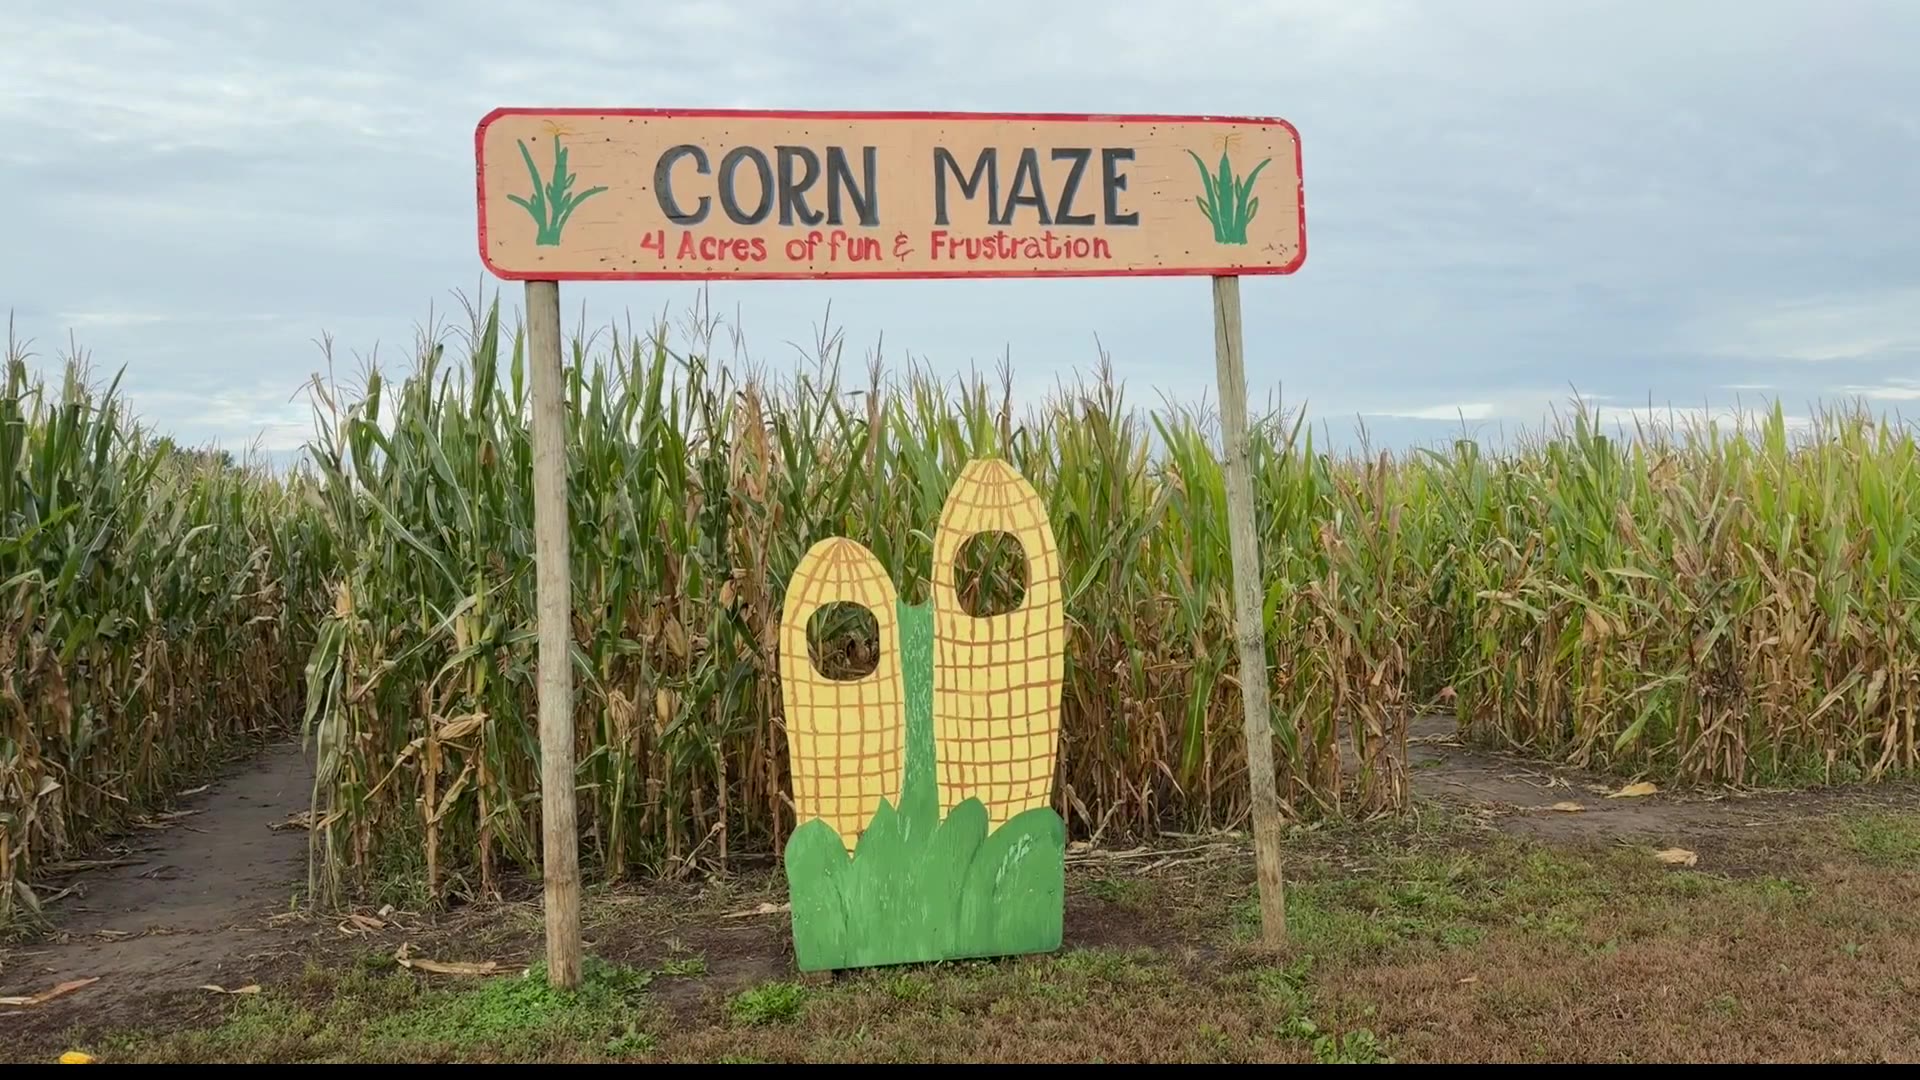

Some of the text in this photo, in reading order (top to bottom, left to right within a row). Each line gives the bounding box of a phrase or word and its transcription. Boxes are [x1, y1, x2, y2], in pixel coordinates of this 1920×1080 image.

[653, 144, 1140, 226] CORN MAZE
[640, 230, 1112, 262] 4 Acres of fun & Frustration
